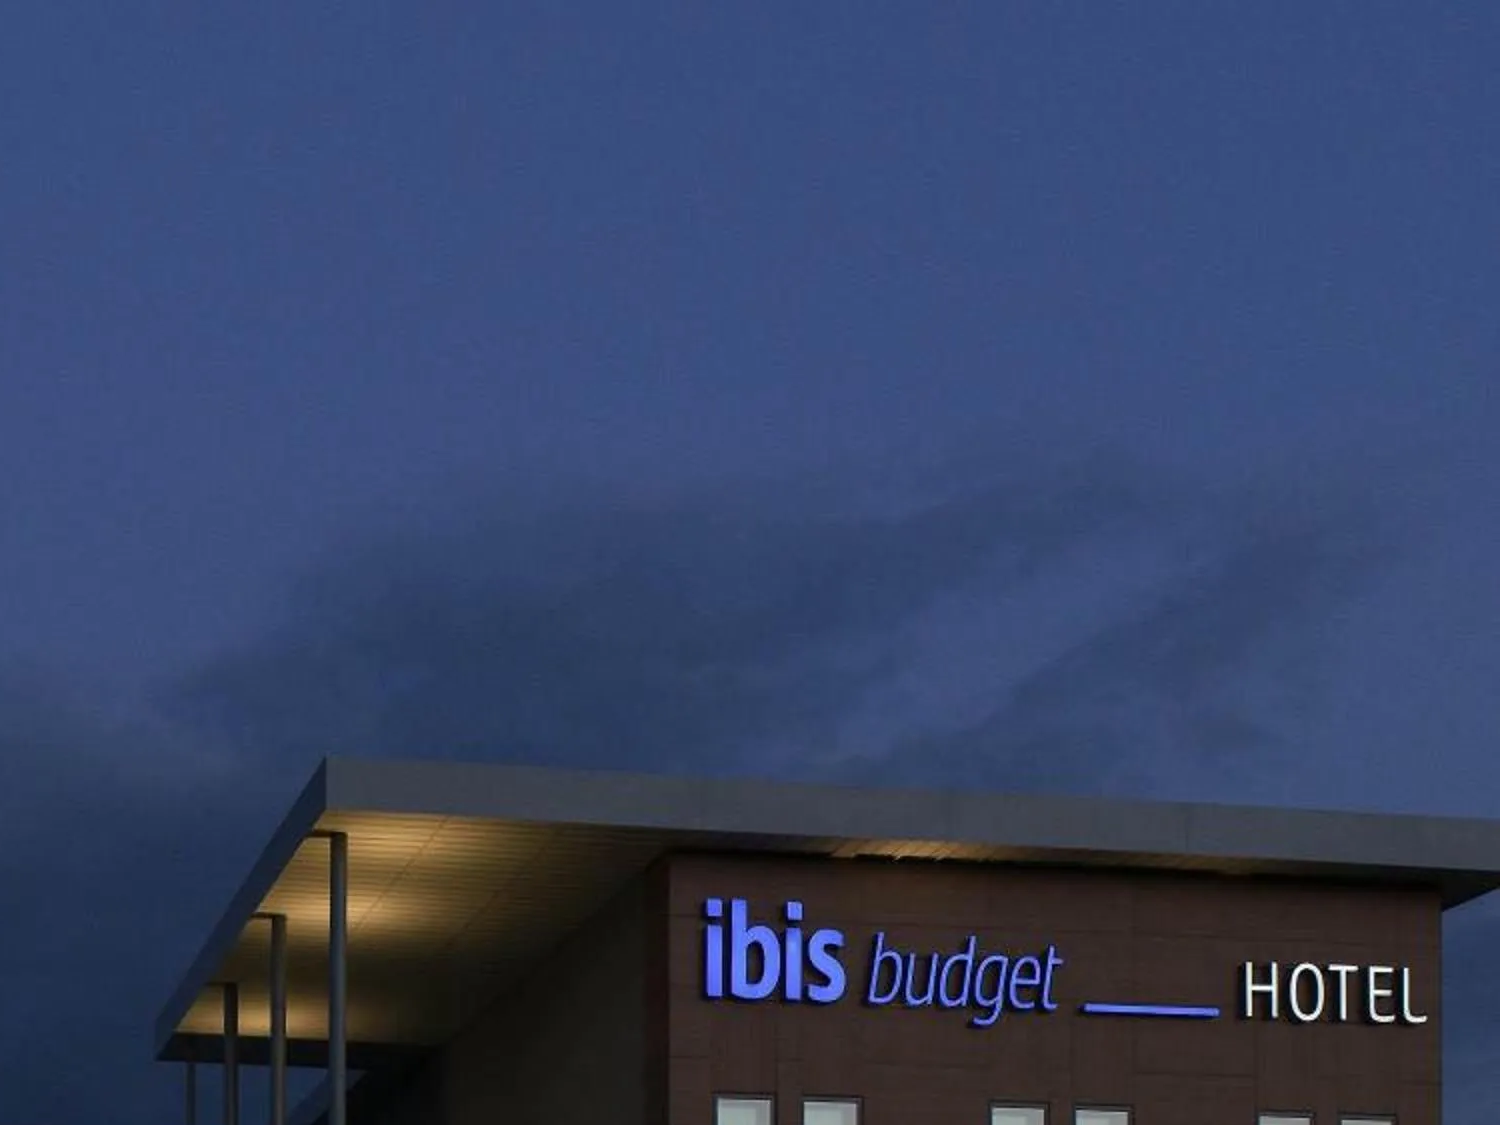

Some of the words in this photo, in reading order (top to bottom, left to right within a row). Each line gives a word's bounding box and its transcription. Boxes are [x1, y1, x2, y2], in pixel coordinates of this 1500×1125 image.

[705, 897, 847, 1003] ibis
[867, 931, 1064, 1026] budget
[1245, 961, 1428, 1024] HOTEL
